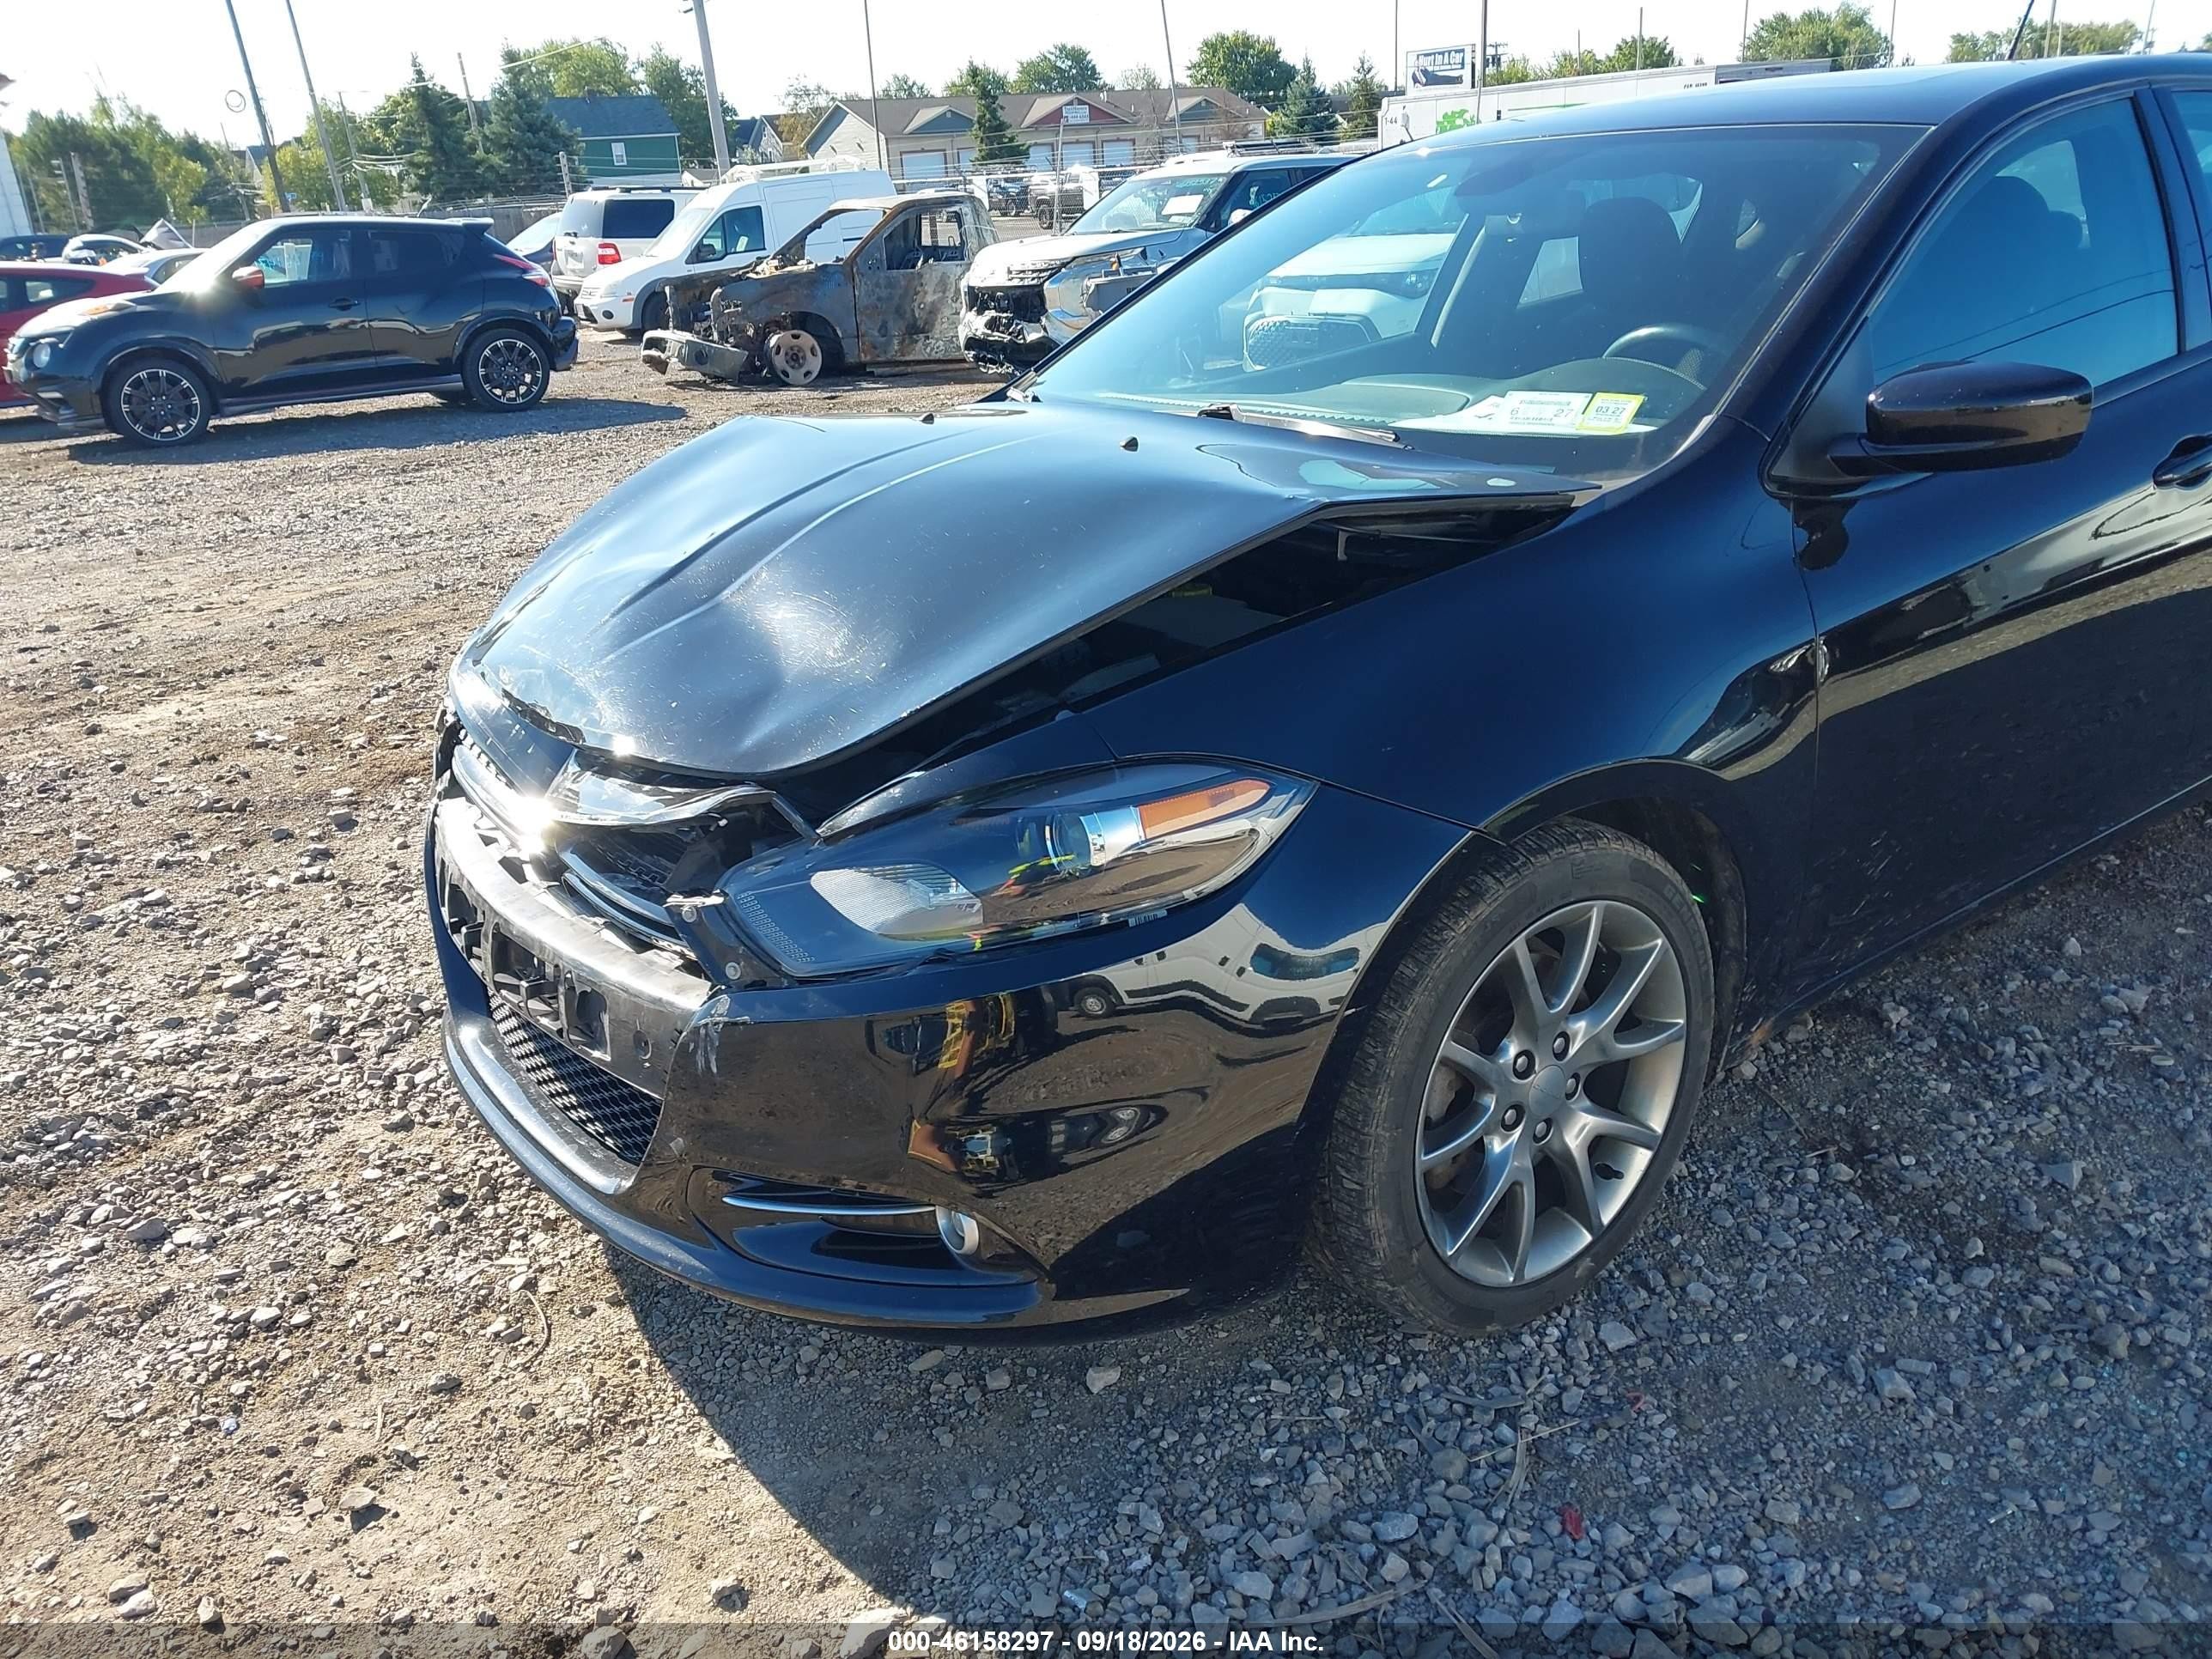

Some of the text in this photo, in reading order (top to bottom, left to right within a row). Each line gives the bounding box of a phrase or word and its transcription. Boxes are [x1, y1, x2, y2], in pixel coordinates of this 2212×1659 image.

[1419, 55, 1434, 67] Hurt
[1443, 52, 1449, 64] A
[1449, 51, 1463, 64] Car
[1553, 408, 1574, 418] 27
